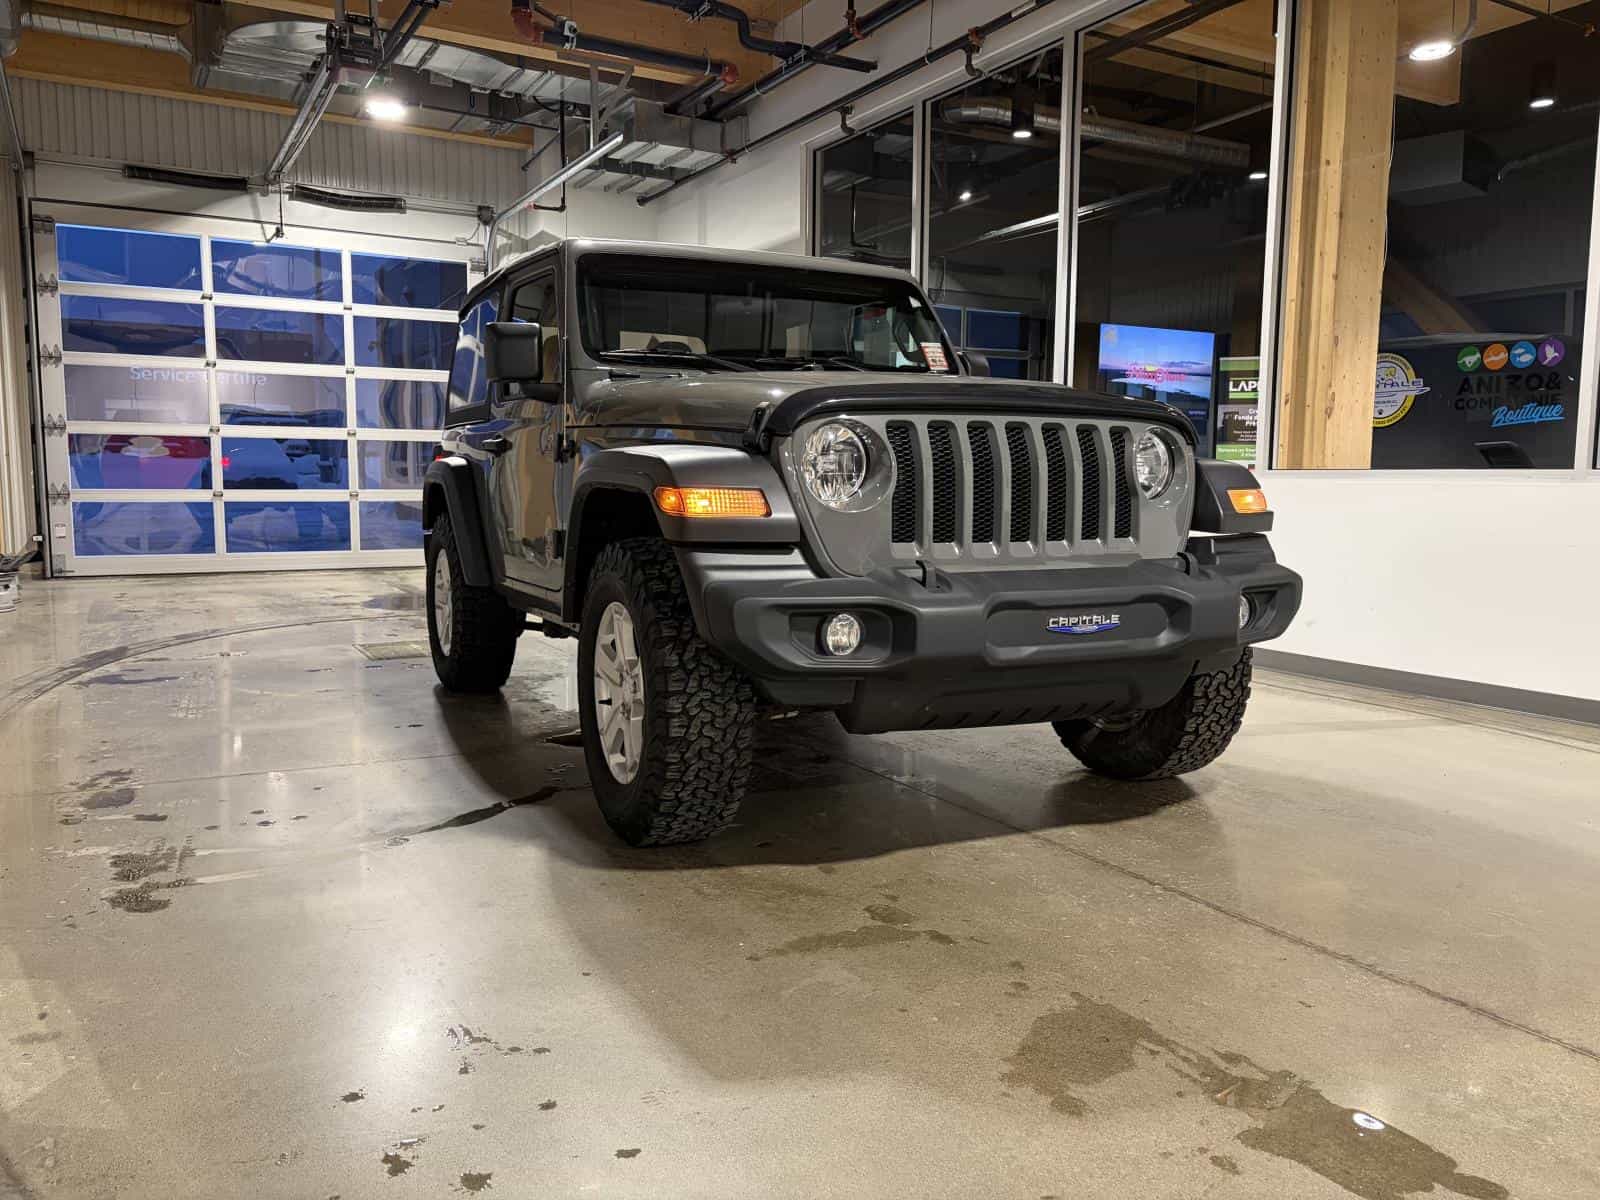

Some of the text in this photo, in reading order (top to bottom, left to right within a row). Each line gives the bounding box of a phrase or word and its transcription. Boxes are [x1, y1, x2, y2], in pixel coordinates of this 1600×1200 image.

[130, 366, 195, 384] Service
[1492, 401, 1564, 424] Boutique
[1048, 614, 1121, 627] CAPITALE
